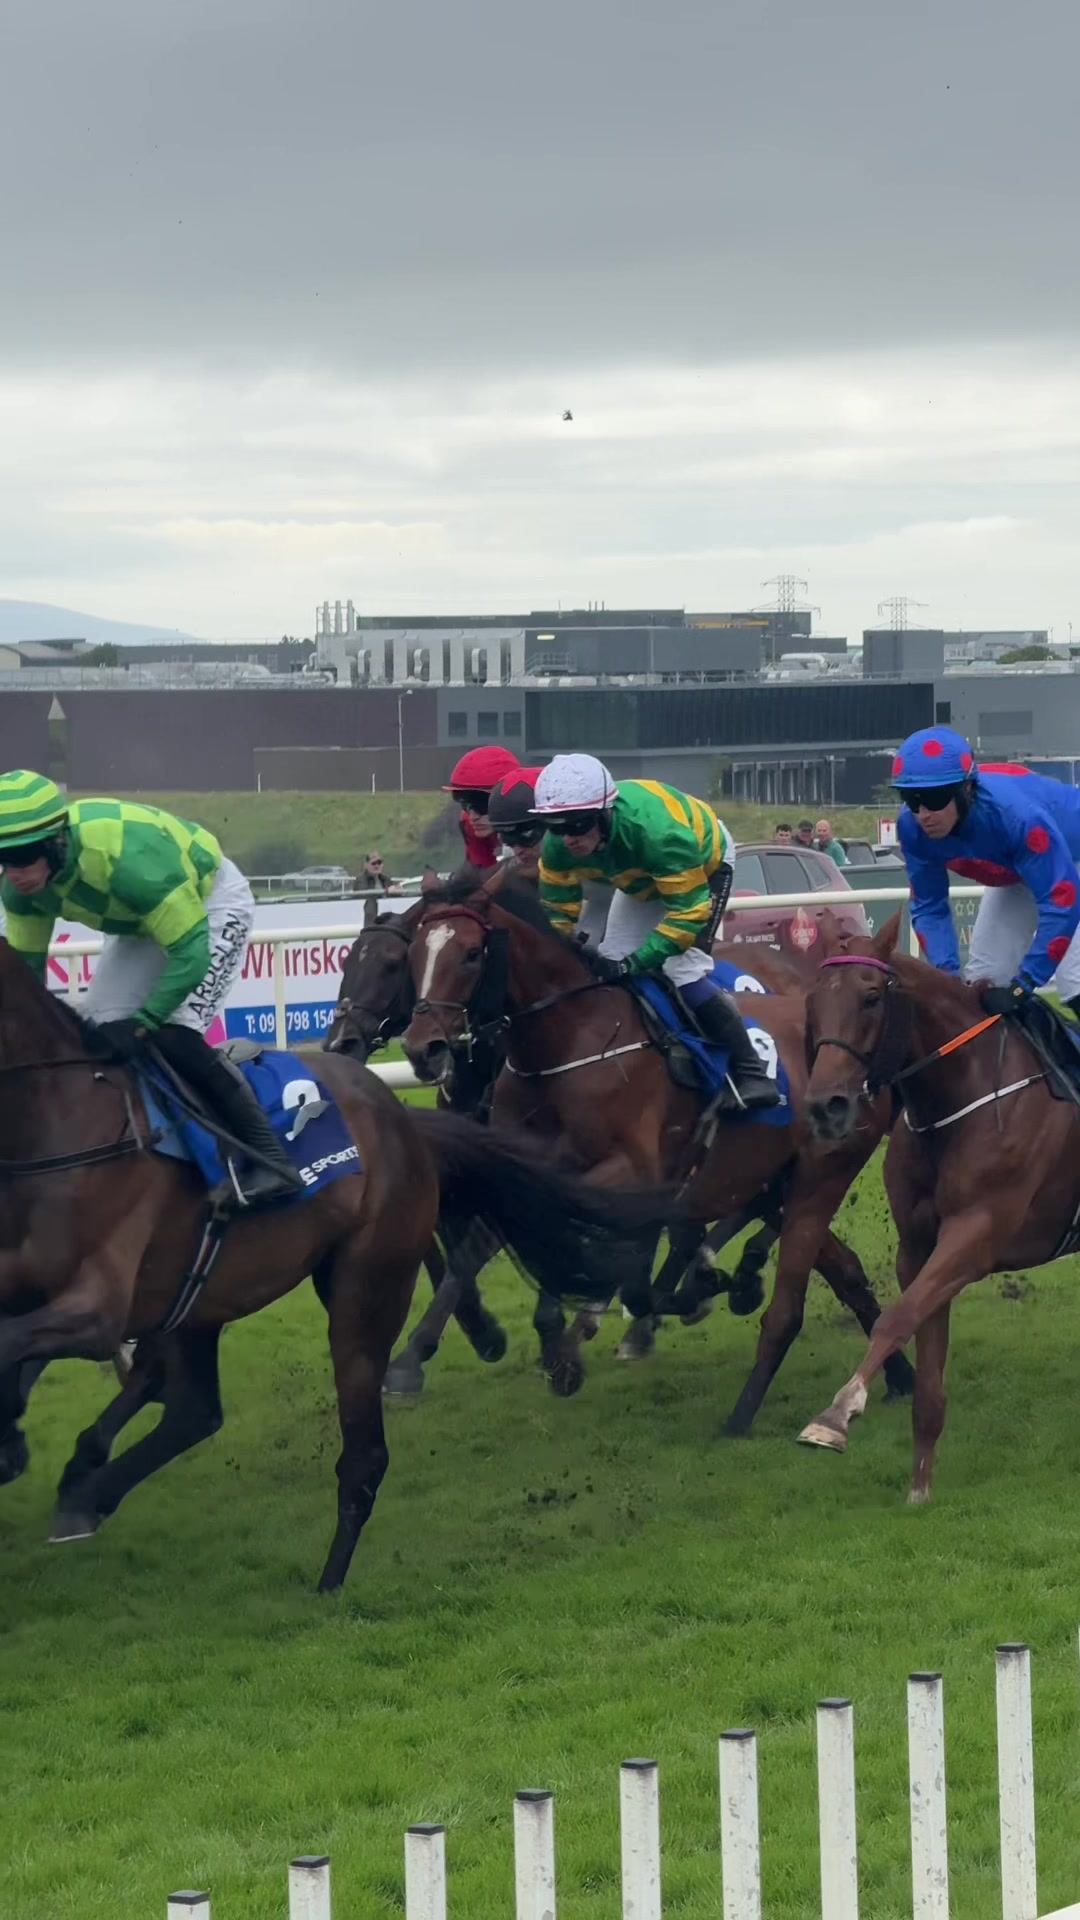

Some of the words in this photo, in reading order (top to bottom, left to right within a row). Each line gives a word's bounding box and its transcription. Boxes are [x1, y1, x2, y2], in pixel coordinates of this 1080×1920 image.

[241, 938, 352, 979] Whiriske
[245, 1014, 256, 1034] T:
[259, 1012, 276, 1033] 09
[286, 1010, 310, 1031] 798
[313, 1008, 336, 1029] 154
[746, 1027, 778, 1079] 9
[282, 1079, 328, 1141] 2
